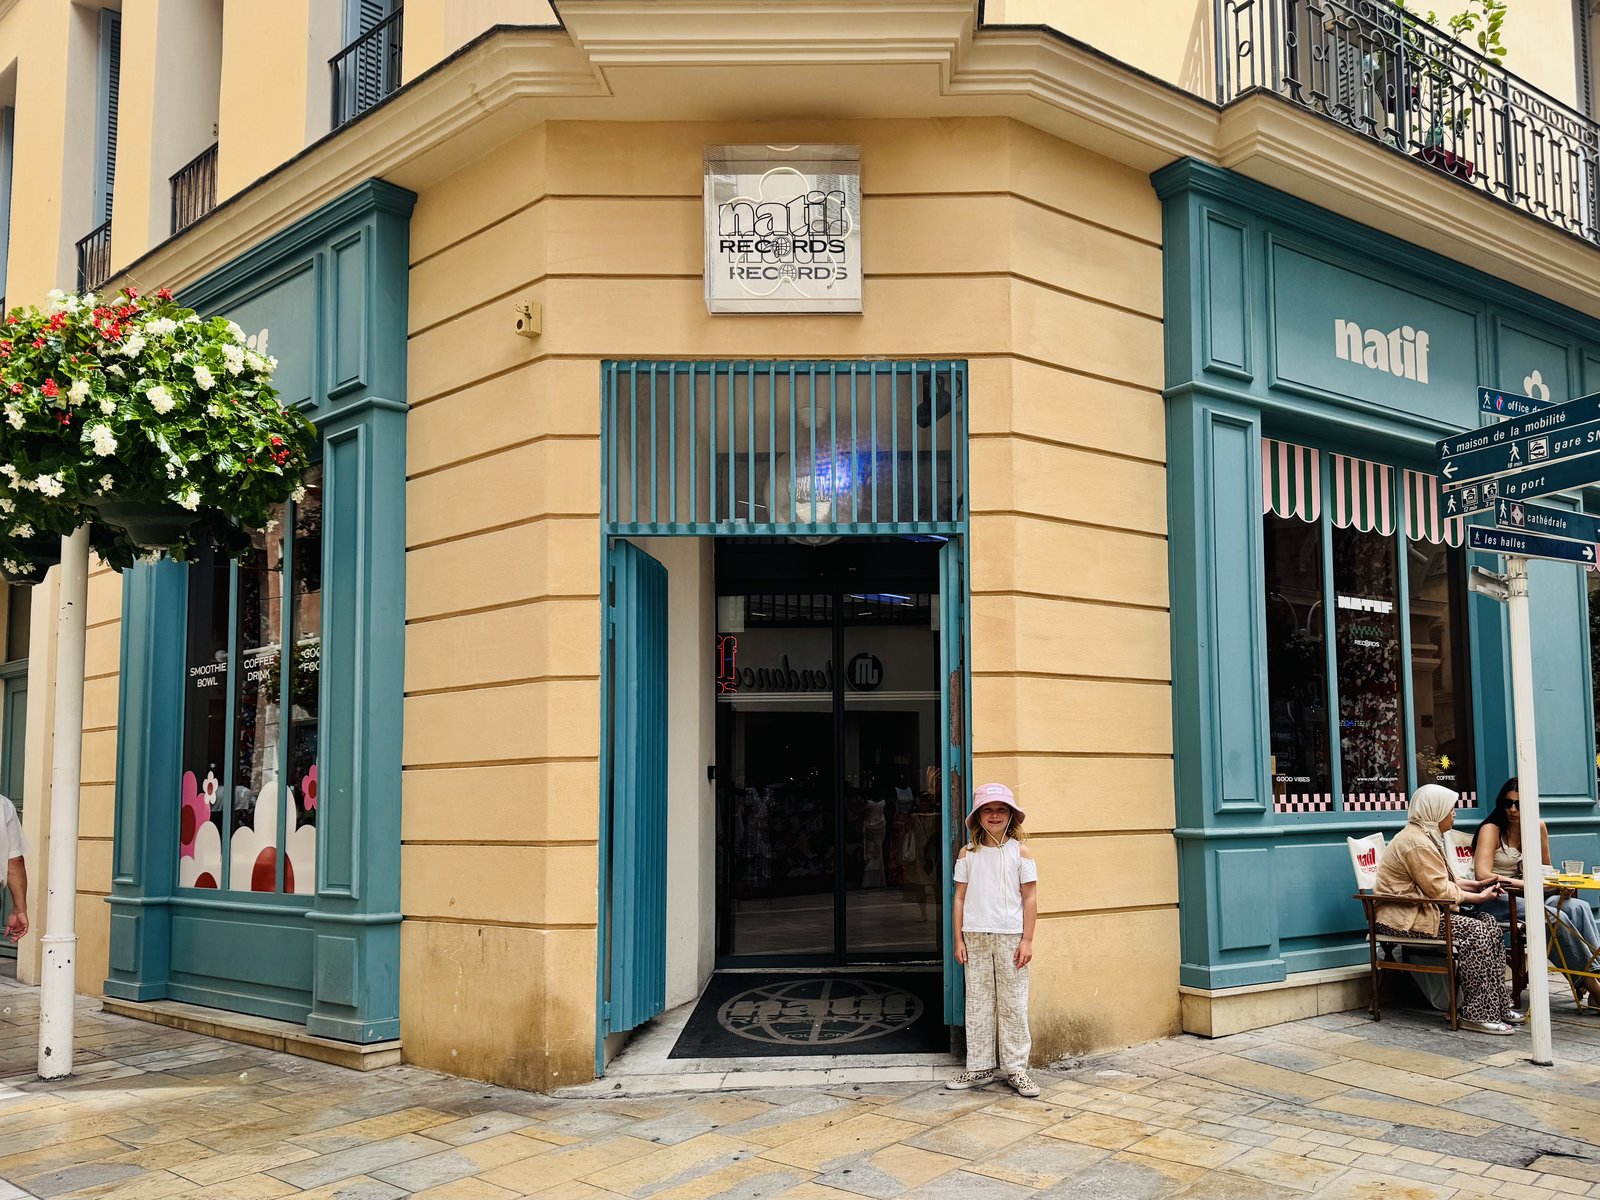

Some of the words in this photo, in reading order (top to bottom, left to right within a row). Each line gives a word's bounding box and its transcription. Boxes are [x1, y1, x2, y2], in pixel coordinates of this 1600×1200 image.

[719, 190, 846, 237] natif
[719, 238, 846, 256] RECORDS
[1334, 319, 1430, 385] natif
[1507, 400, 1530, 414] office
[1456, 437, 1489, 453] maison
[1493, 430, 1505, 442] de
[1510, 425, 1520, 437] la
[1525, 411, 1566, 433] mobilité
[1554, 437, 1581, 454] gare
[1506, 484, 1516, 494] le
[1521, 476, 1546, 493] port
[1527, 512, 1567, 529] cathédrale
[1484, 534, 1497, 546] les
[1500, 535, 1526, 549] halles
[189, 662, 228, 677] SMOOTHIE
[243, 654, 275, 670] COFFEE
[197, 678, 219, 688] BOWL
[247, 669, 271, 682] DRINK
[1276, 775, 1293, 783] GOOD
[1293, 775, 1311, 783] VIBES
